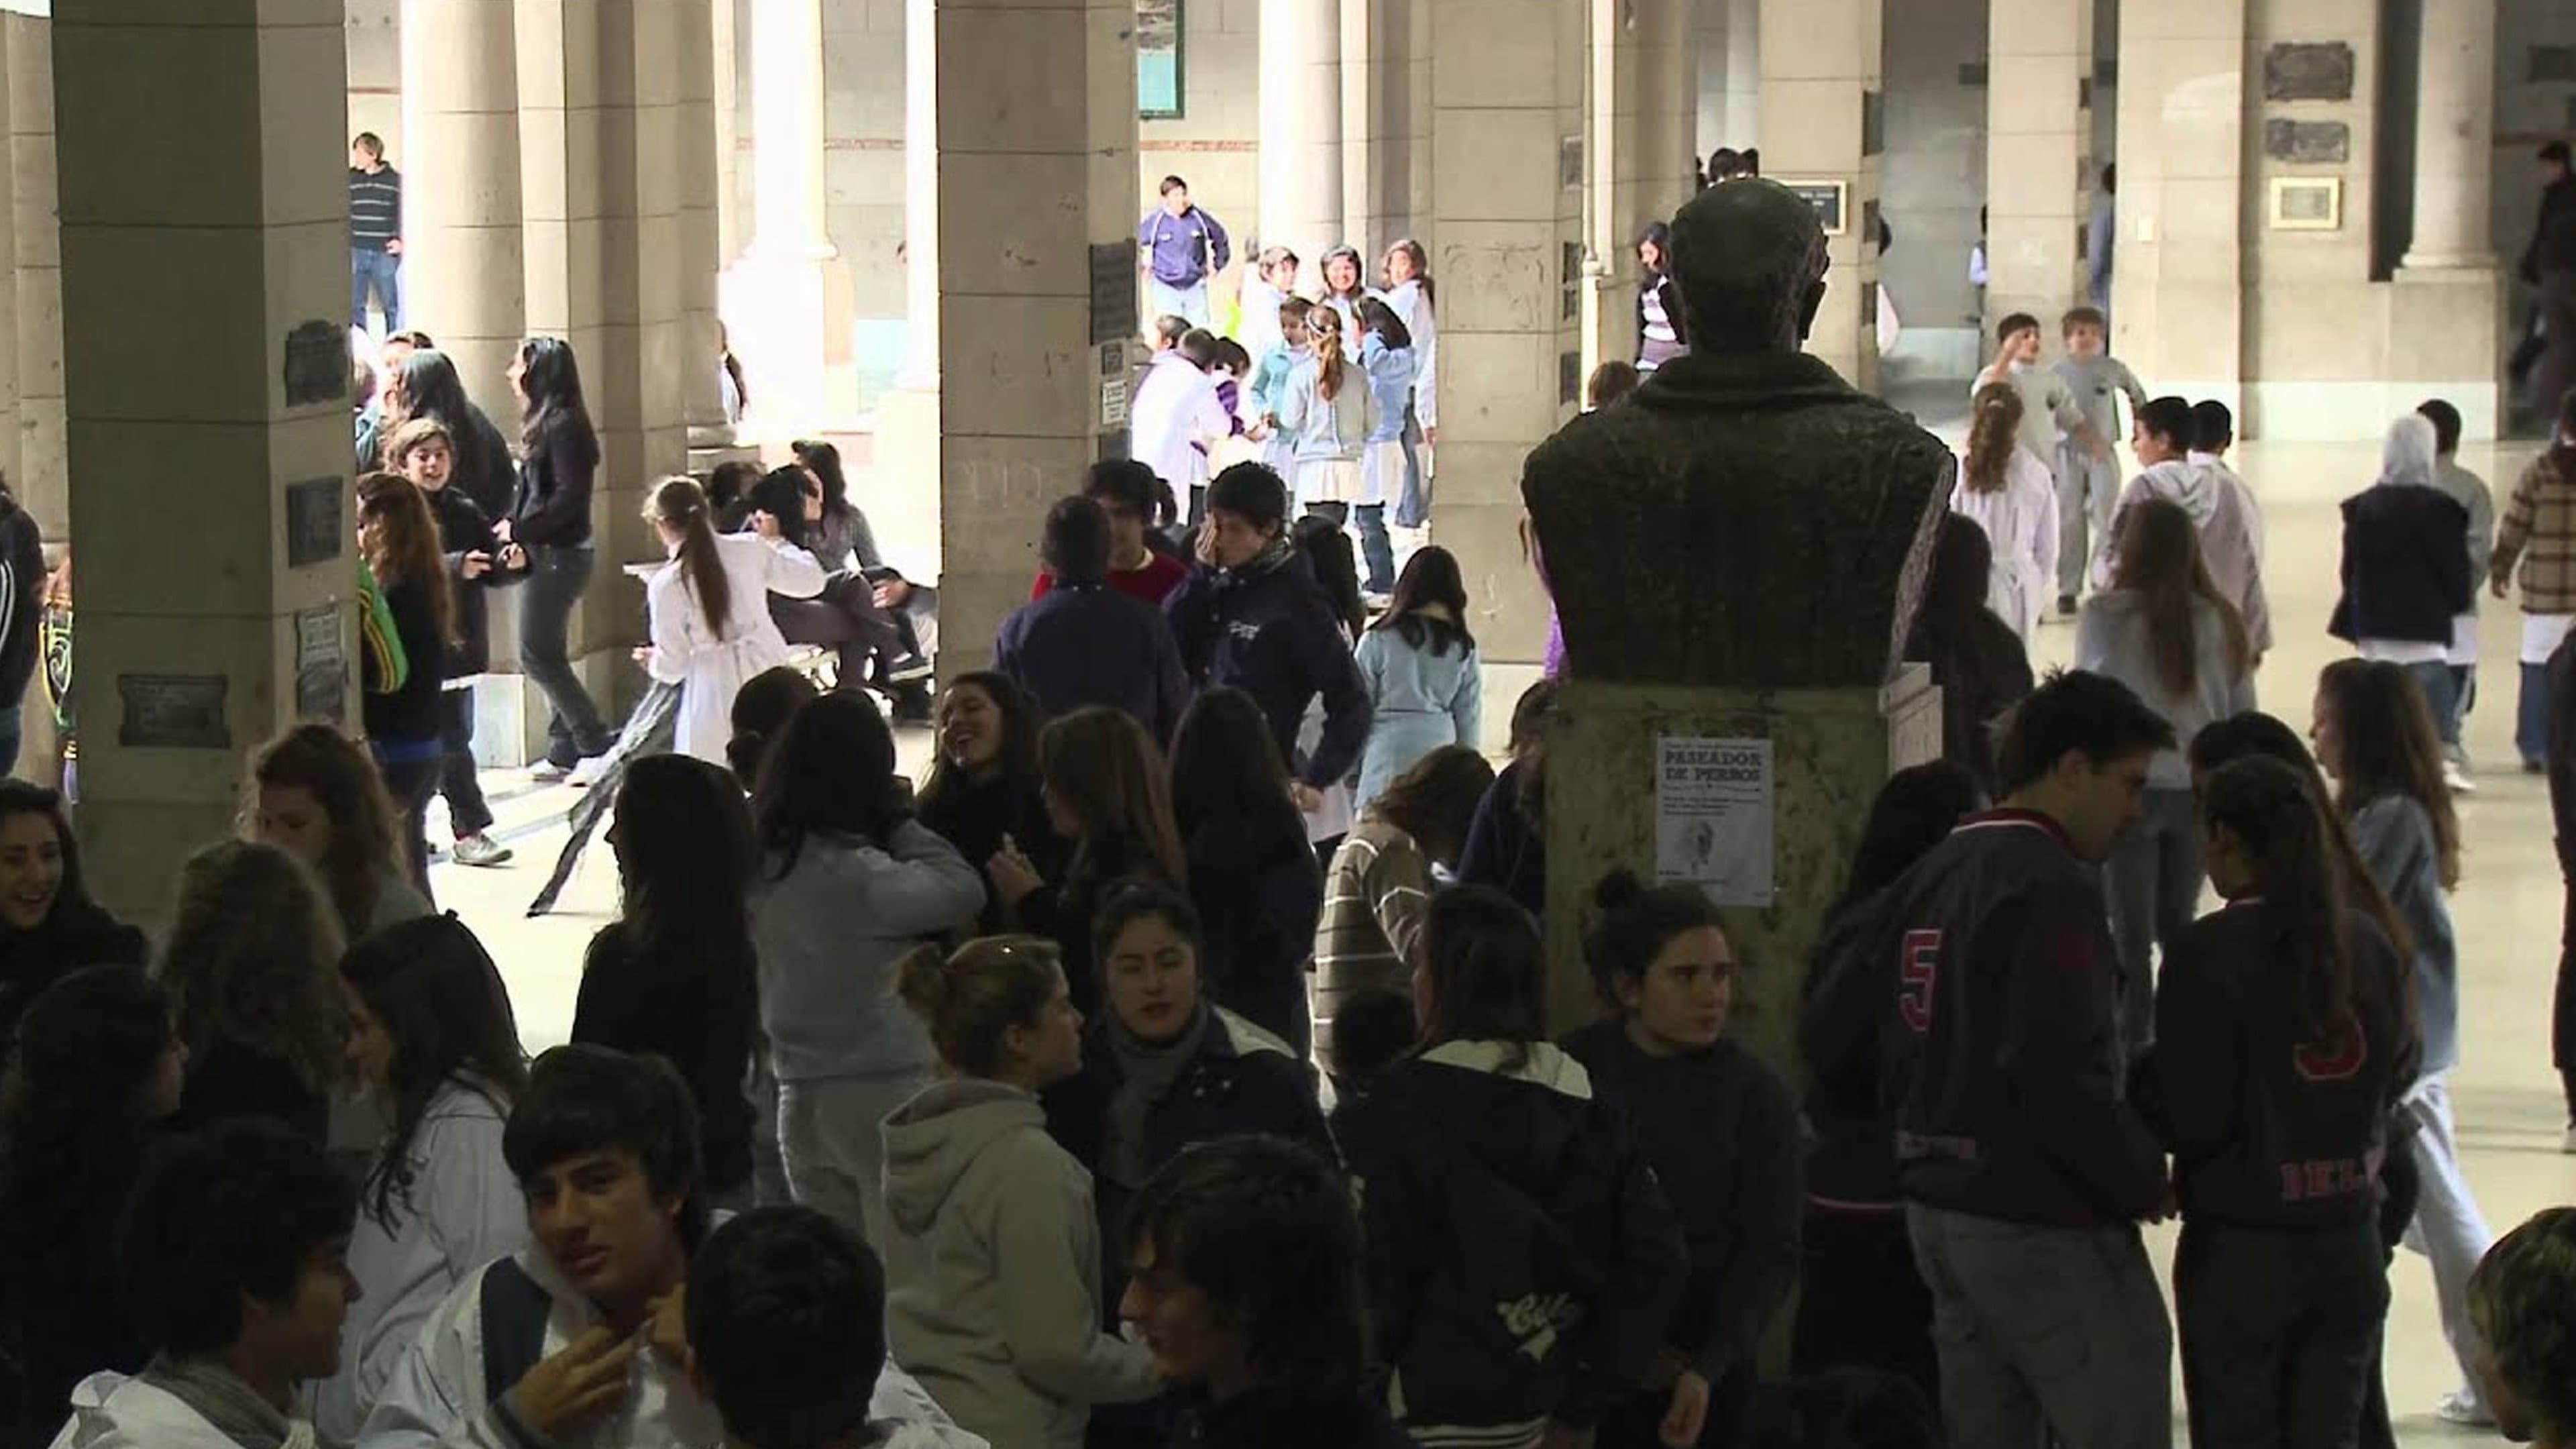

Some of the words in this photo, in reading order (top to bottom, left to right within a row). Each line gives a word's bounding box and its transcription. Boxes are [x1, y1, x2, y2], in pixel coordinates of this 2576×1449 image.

[1665, 751, 1762, 766] PASEADOR
[1666, 767, 1688, 780] DE
[1695, 768, 1761, 782] PERROS
[1900, 928, 1942, 1031] 5
